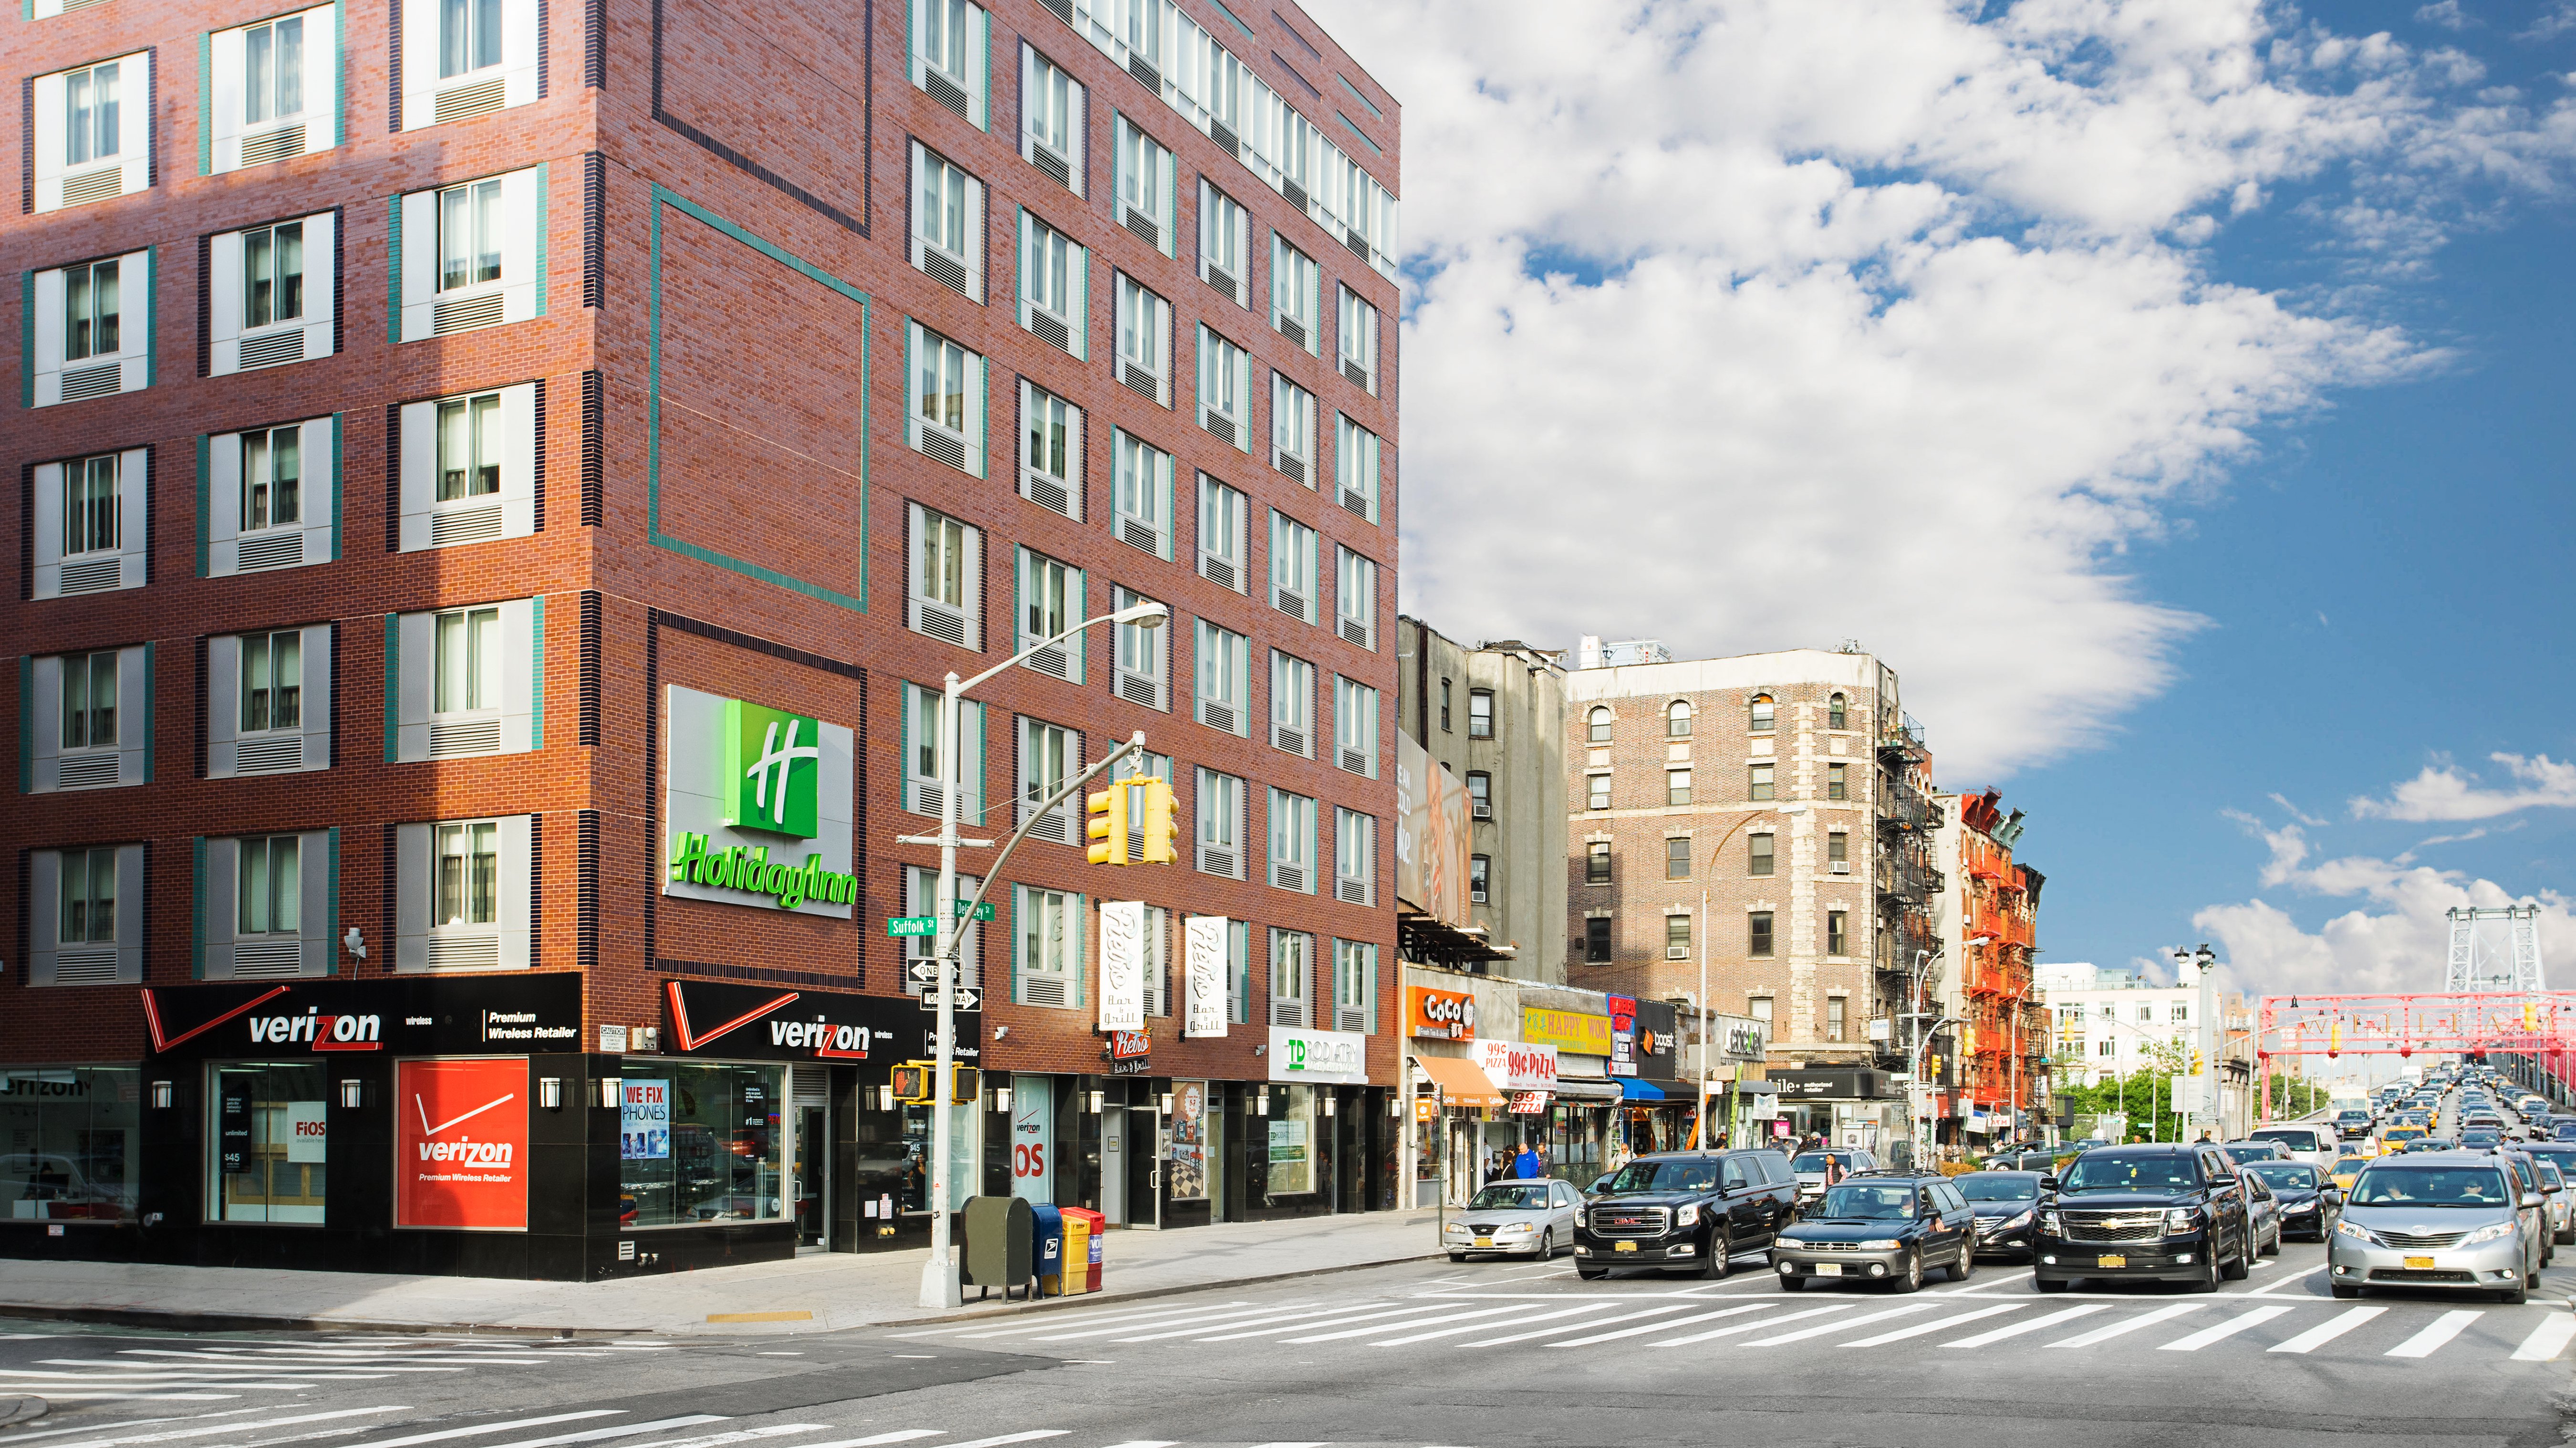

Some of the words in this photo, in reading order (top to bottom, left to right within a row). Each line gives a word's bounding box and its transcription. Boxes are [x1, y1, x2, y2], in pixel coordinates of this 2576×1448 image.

[1402, 768, 1411, 791] AN
[1397, 815, 1412, 865] ke.
[958, 902, 983, 919] Deley
[893, 920, 924, 934] Suffolk
[928, 919, 934, 928] St
[1106, 907, 1138, 990] Retro
[1191, 922, 1221, 999] Retro
[920, 967, 938, 975] ONE
[930, 994, 938, 1003] ON
[955, 995, 972, 1004] WAY
[1108, 995, 1133, 1004] Bar
[1194, 1004, 1218, 1013] Bar
[406, 1016, 432, 1025] wireless
[489, 1012, 536, 1023] Premium
[250, 1007, 383, 1051] verizon
[489, 1028, 532, 1039] Wireless
[534, 1027, 576, 1038] Retailer
[1548, 1014, 1581, 1037] HAPPY
[1588, 1018, 1607, 1040] WOK
[771, 1015, 869, 1059] verizon
[875, 1031, 893, 1039] wireless
[1654, 1031, 1673, 1047] boost
[1730, 1024, 1762, 1052] cricket
[1117, 1030, 1149, 1055] Retro
[1488, 1043, 1506, 1056] 99¢
[955, 1047, 979, 1056] Retailer
[1289, 1039, 1305, 1062] TD
[1307, 1041, 1359, 1063] PODIATRY
[1114, 1063, 1129, 1073] Bar
[1486, 1058, 1506, 1068] PIZZA
[1508, 1051, 1527, 1077] 99¢
[0, 1079, 83, 1096] erizon
[626, 1086, 643, 1103] WE
[646, 1087, 663, 1103] FIX
[623, 1105, 665, 1120] PHONES
[1510, 1103, 1540, 1113] PIZZA
[746, 1117, 752, 1125] #1
[768, 1115, 780, 1125] PEN
[296, 1122, 325, 1135] FiOS
[1017, 1122, 1040, 1134] verizon
[225, 1154, 239, 1162] $45
[419, 1136, 512, 1168] verizon
[1016, 1144, 1044, 1177] OS
[452, 1174, 481, 1182] Wireless
